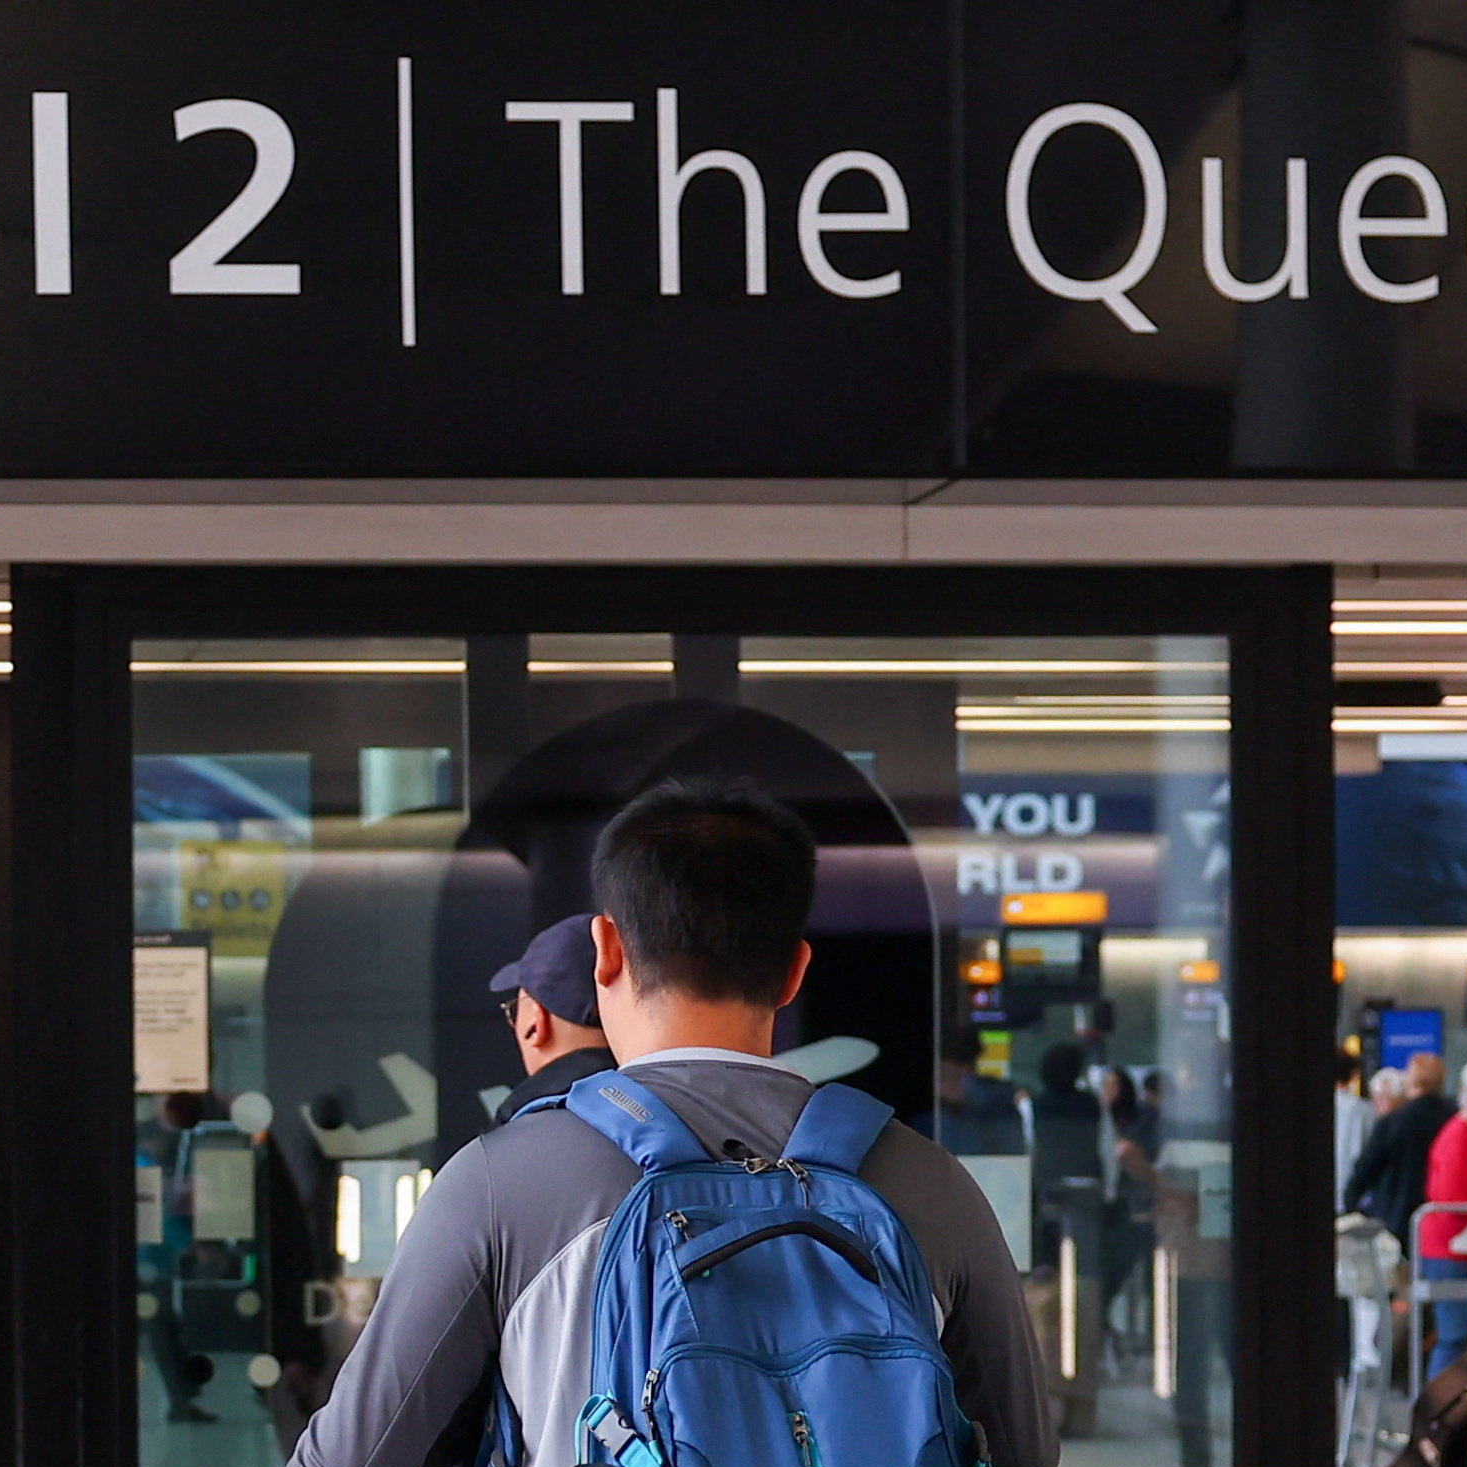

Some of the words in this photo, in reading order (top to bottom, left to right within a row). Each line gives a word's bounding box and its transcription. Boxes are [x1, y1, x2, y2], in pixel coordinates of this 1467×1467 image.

[170, 99, 301, 294] 2
[506, 88, 909, 298] The
[962, 792, 1096, 837] YOU
